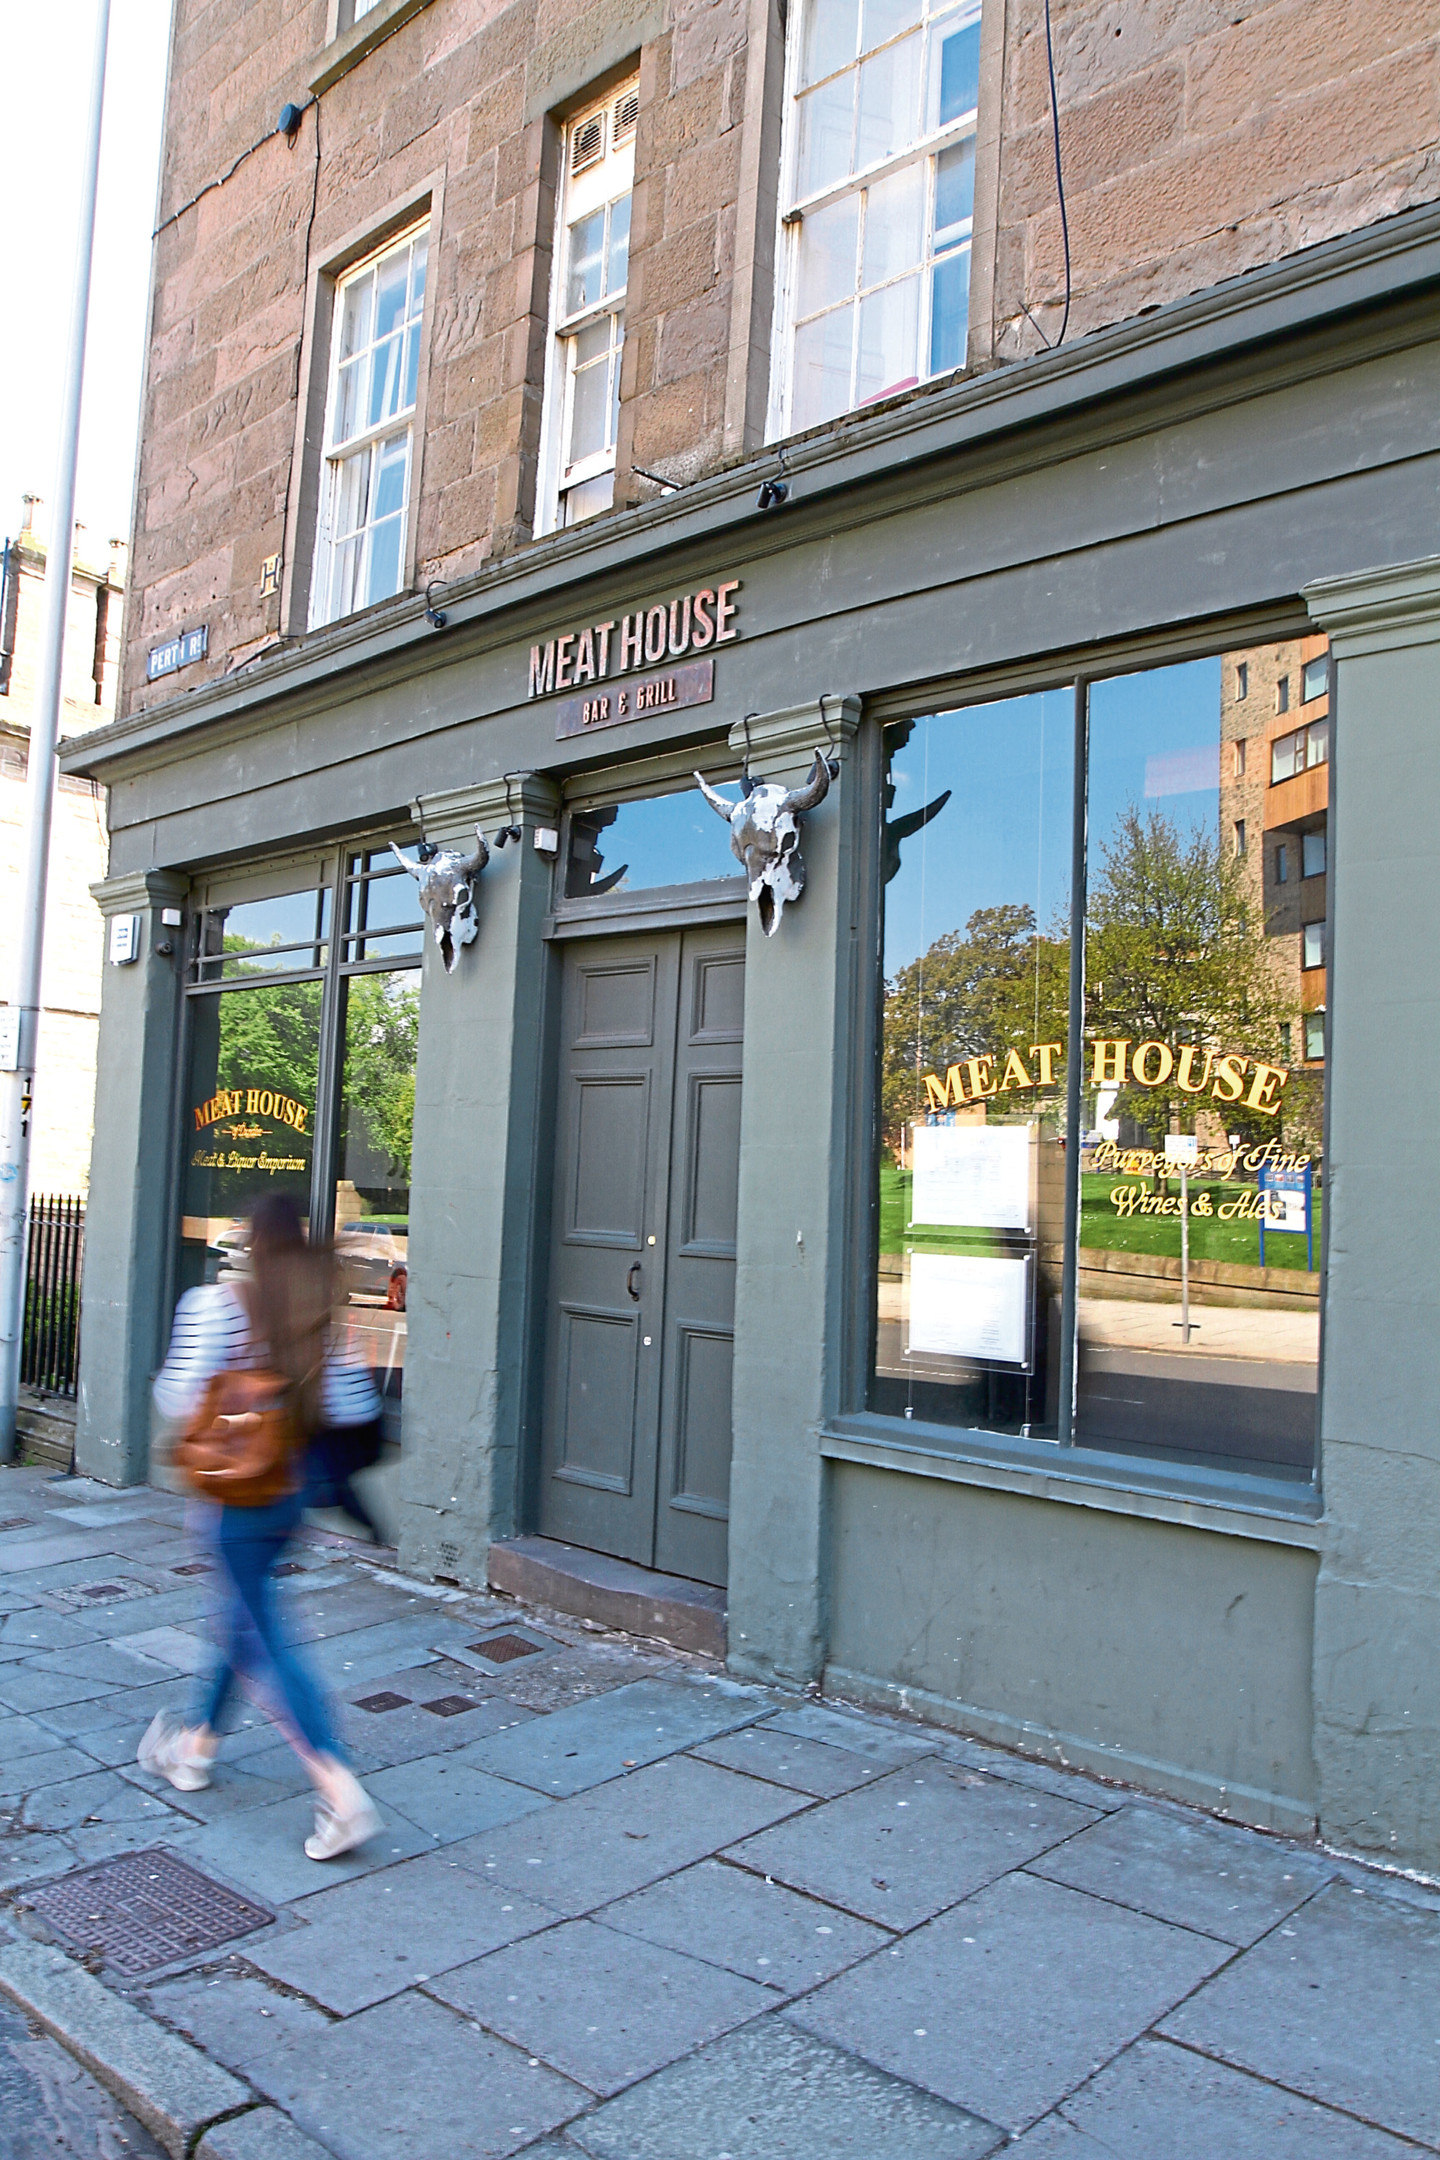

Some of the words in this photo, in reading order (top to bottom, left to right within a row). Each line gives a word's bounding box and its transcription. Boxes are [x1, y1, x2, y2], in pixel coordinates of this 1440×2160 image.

[261, 556, 279, 595] H
[528, 620, 617, 698] MEAT
[620, 579, 742, 671] HOUSE
[582, 696, 609, 725] BAR
[617, 691, 628, 715] &
[636, 678, 677, 710] GRILL
[921, 1042, 1063, 1115] MEAT
[1088, 1039, 1289, 1117] HOUSE
[194, 1090, 243, 1132] MEAT
[245, 1088, 309, 1133] HOUSE
[216, 1152, 226, 1169] &
[257, 1151, 306, 1176] Emporium
[1091, 1138, 1213, 1180] Purveyors
[1217, 1143, 1251, 1181] of
[1242, 1136, 1311, 1174] Fine
[1110, 1181, 1189, 1218] Wines
[1190, 1191, 1215, 1217] &
[1217, 1189, 1285, 1221] Ales
